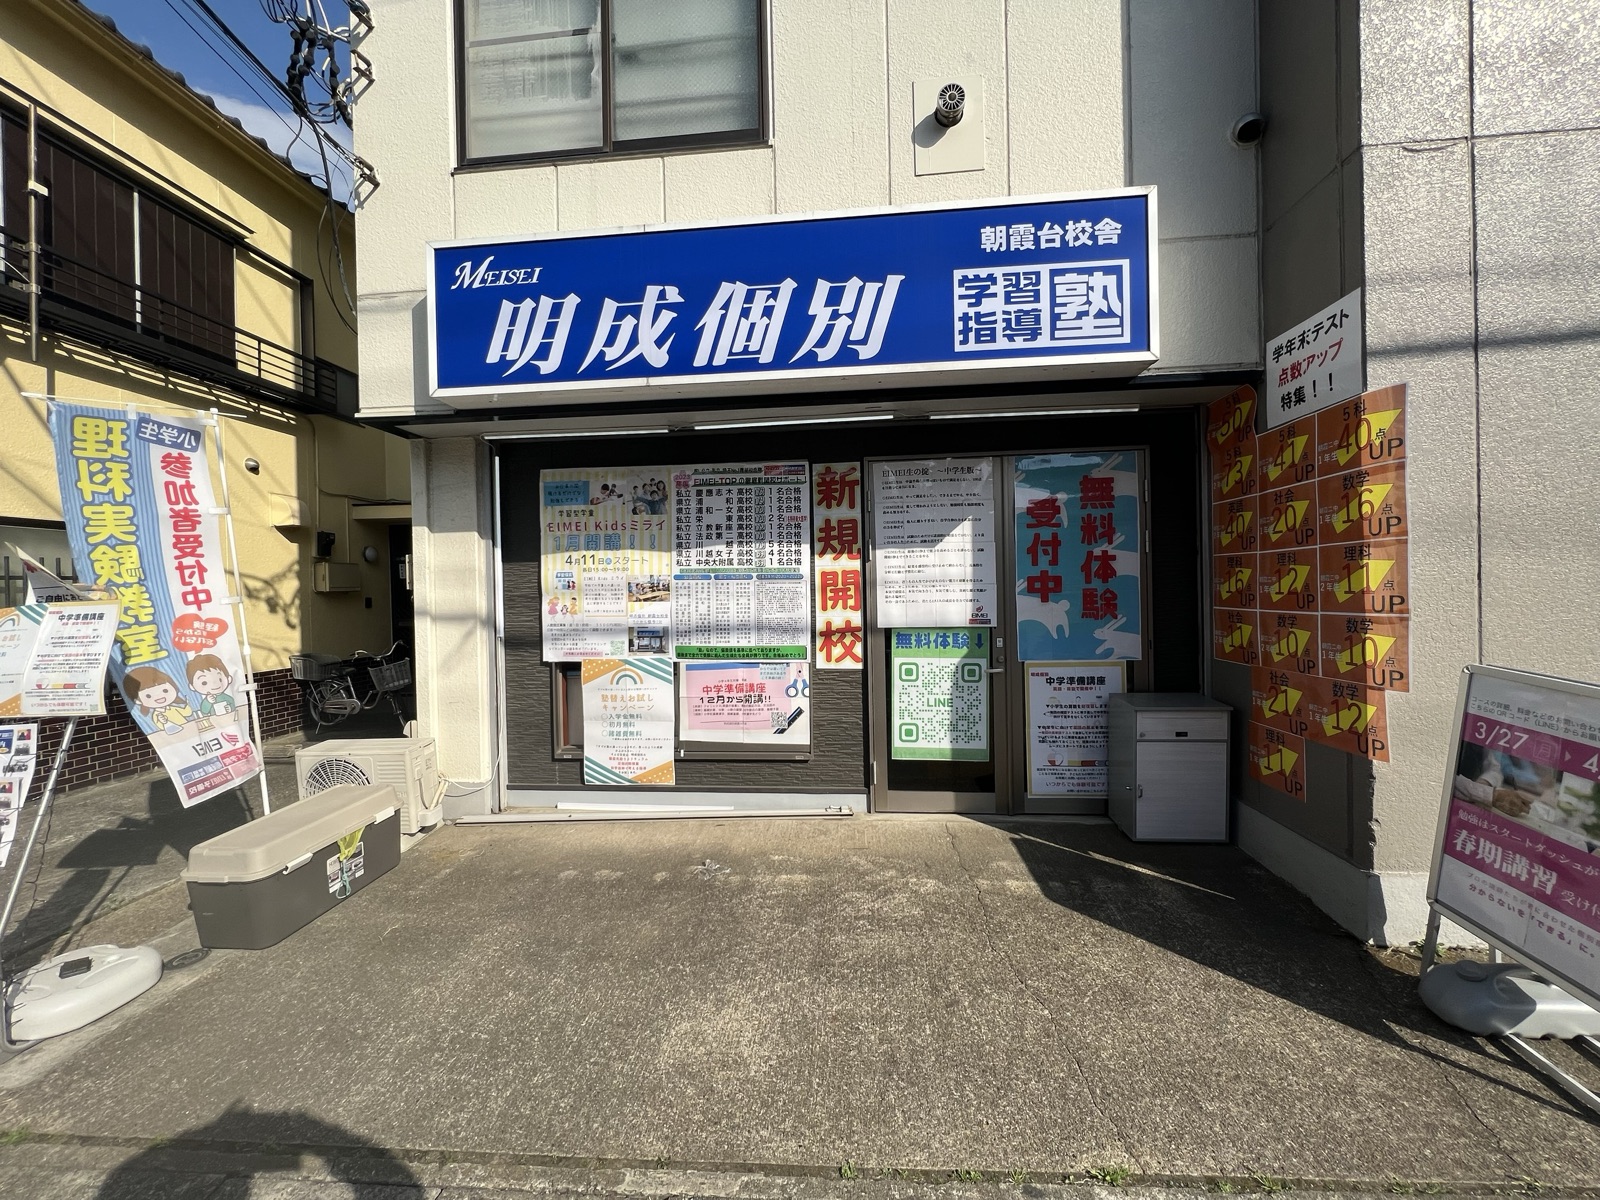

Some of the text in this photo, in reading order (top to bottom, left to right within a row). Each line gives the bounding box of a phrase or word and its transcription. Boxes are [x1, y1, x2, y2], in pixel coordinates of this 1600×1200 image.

[980, 216, 1122, 252] 朝霞台校舎
[451, 256, 542, 292] MEISEI
[957, 269, 1042, 308] 学習
[1052, 269, 1123, 342] 塾
[486, 274, 905, 378] 明成個別
[957, 306, 1042, 346] 指導
[1272, 308, 1349, 364] 学年末テスト
[1278, 337, 1344, 388] 点数アップ
[1280, 372, 1333, 412] 特集！！
[1343, 399, 1366, 422] 5科
[1237, 425, 1252, 443] UP
[1374, 428, 1386, 441] 点
[1369, 438, 1404, 460] UP
[1294, 463, 1315, 482] UP
[1342, 470, 1370, 491] 数学
[737, 488, 753, 496] 高校
[1242, 480, 1256, 494] UP
[737, 497, 753, 505] 高校
[1273, 489, 1295, 506] 社会
[737, 506, 753, 514] 高校
[1381, 503, 1394, 515] 点
[548, 521, 588, 532] EIMEI
[737, 515, 753, 523] 高校
[1368, 516, 1402, 536] UP
[737, 532, 753, 540] 高校
[1241, 536, 1256, 550] UP
[1295, 528, 1314, 546] UP
[737, 550, 753, 558] 高校
[1026, 498, 1063, 603] 受付中
[1079, 475, 1118, 620] 無料体験
[1343, 544, 1372, 562] 理科
[737, 558, 753, 566] 高校
[817, 466, 862, 663] 新規開校
[1277, 552, 1297, 566] 理科
[1382, 579, 1396, 591] 点
[1240, 593, 1255, 607] UP
[1296, 594, 1315, 610] UP
[1372, 594, 1406, 613] UP
[1276, 615, 1297, 628] 数学
[1345, 617, 1374, 634] 数学
[895, 632, 970, 649] 無料体験
[1242, 651, 1257, 664] UP
[1296, 659, 1316, 674] UP
[1384, 656, 1396, 668] 点
[1046, 676, 1106, 686] 中学準備講座
[1269, 671, 1290, 688] 社会
[1372, 668, 1404, 687] UP
[702, 682, 767, 695] 中学準備講座
[1331, 682, 1359, 700] 数学
[927, 698, 953, 708] LINE
[1289, 718, 1308, 737] UP
[1475, 722, 1530, 750] 3/27
[1265, 728, 1286, 746] 理科
[1357, 735, 1385, 757] UP
[1284, 776, 1303, 796] UP
[1453, 828, 1558, 896] 春期講習
